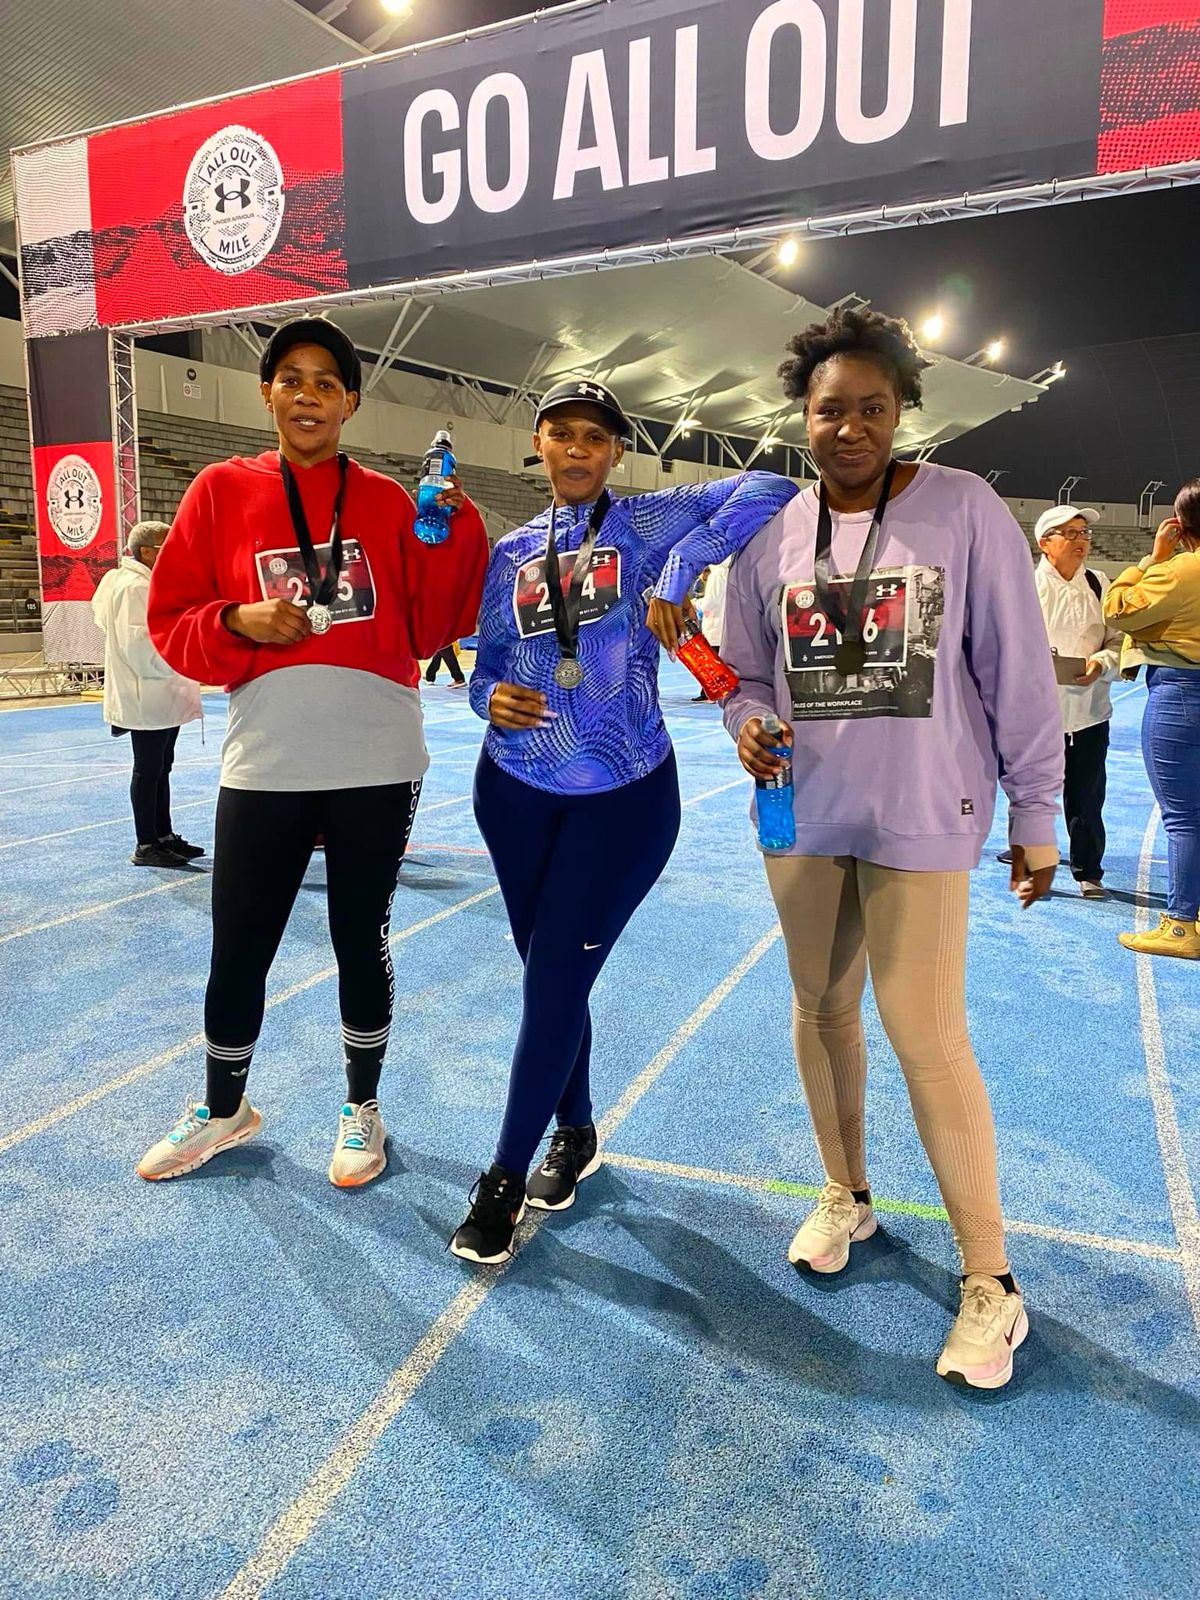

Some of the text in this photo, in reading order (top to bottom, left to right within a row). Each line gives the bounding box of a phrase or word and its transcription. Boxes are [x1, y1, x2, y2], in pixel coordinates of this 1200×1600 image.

[404, 0, 973, 225] GO ALL OUT
[206, 147, 257, 177] ALL OUT
[219, 235, 250, 254] MILE
[59, 468, 88, 486] ALL OUT
[66, 525, 85, 537] MILE
[286, 570, 354, 607] 25
[535, 571, 597, 613] 24
[826, 699, 863, 707] WORKPLACE
